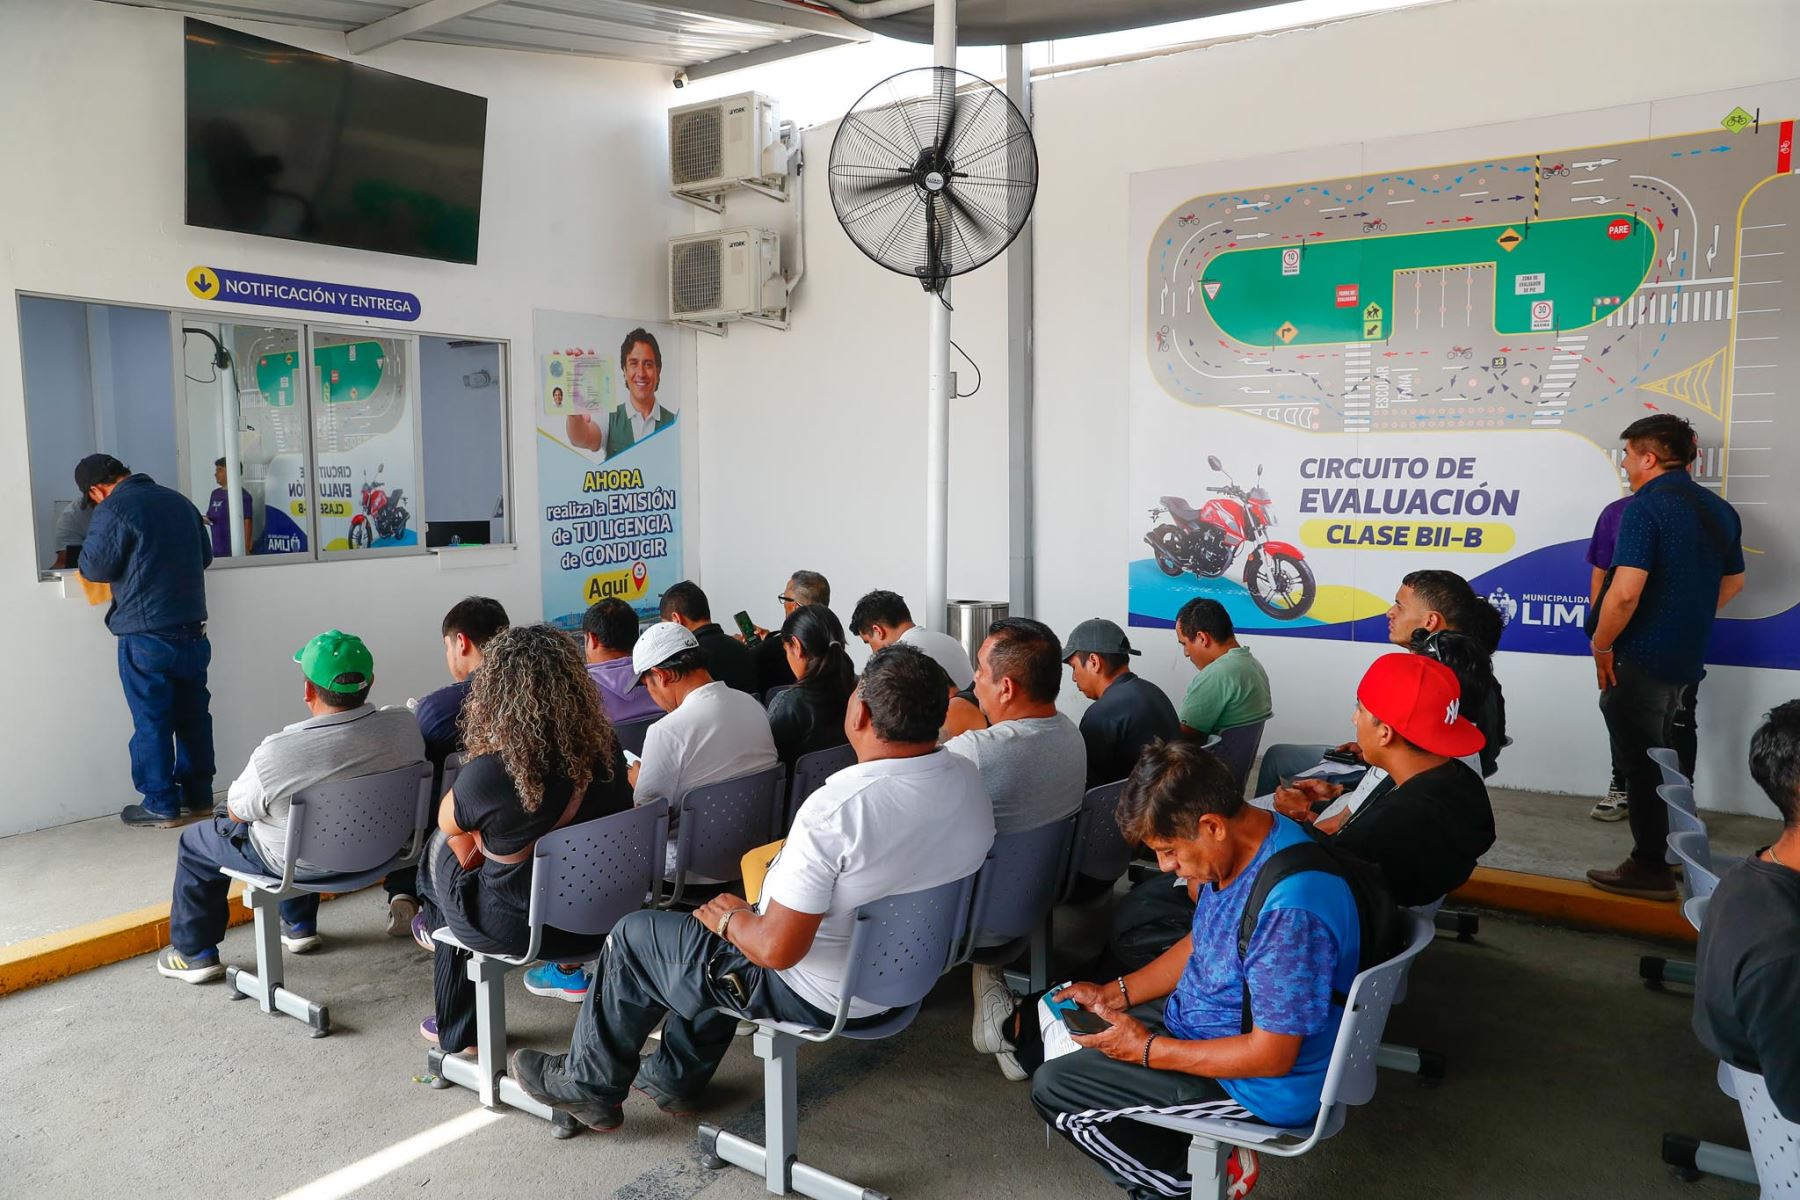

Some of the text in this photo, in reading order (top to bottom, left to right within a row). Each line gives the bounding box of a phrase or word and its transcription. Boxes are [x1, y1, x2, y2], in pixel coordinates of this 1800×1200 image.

[1608, 224, 1630, 235] PARE
[1287, 252, 1295, 260] 10
[225, 278, 412, 313] NOTIFICACIÓN Y ENTREGA
[1538, 305, 1546, 313] 30
[1375, 366, 1390, 409] ESCOLAR
[1397, 373, 1412, 400] ZONA
[583, 469, 645, 492] AHORA
[1300, 457, 1476, 479] CIRCUITO DE
[547, 487, 675, 520] realiza la EMISIÓN
[1299, 481, 1520, 516] EVALUACIÓN
[552, 513, 673, 546] de TU LICENCIA
[1326, 525, 1483, 548] CLASE BII-B
[561, 538, 667, 570] de CONDUCIR
[588, 573, 629, 599] Aquí
[1522, 593, 1590, 604] MUNICIPALIDA
[1521, 602, 1585, 627] LIM
